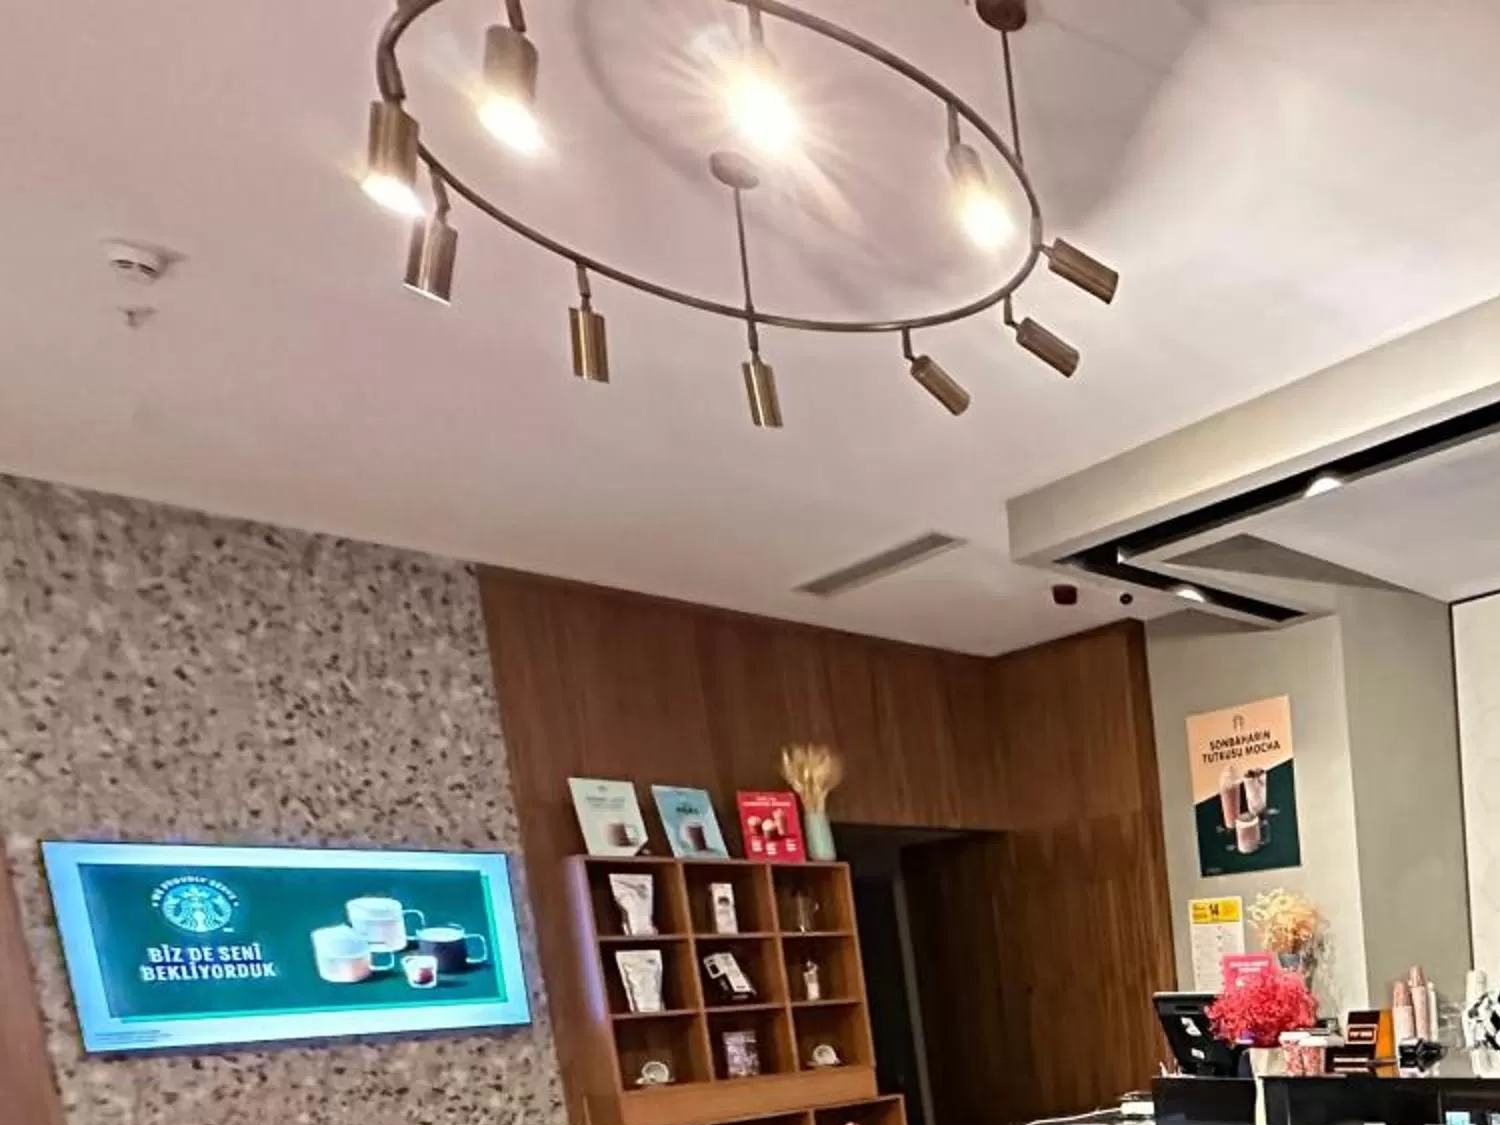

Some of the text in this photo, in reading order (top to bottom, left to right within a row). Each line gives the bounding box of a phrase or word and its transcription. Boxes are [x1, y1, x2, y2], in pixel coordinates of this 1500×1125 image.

[1245, 740, 1280, 755] MOCHA
[147, 941, 262, 963] BİZ DE SENİ
[139, 962, 277, 981] BEKLİYORDUK
